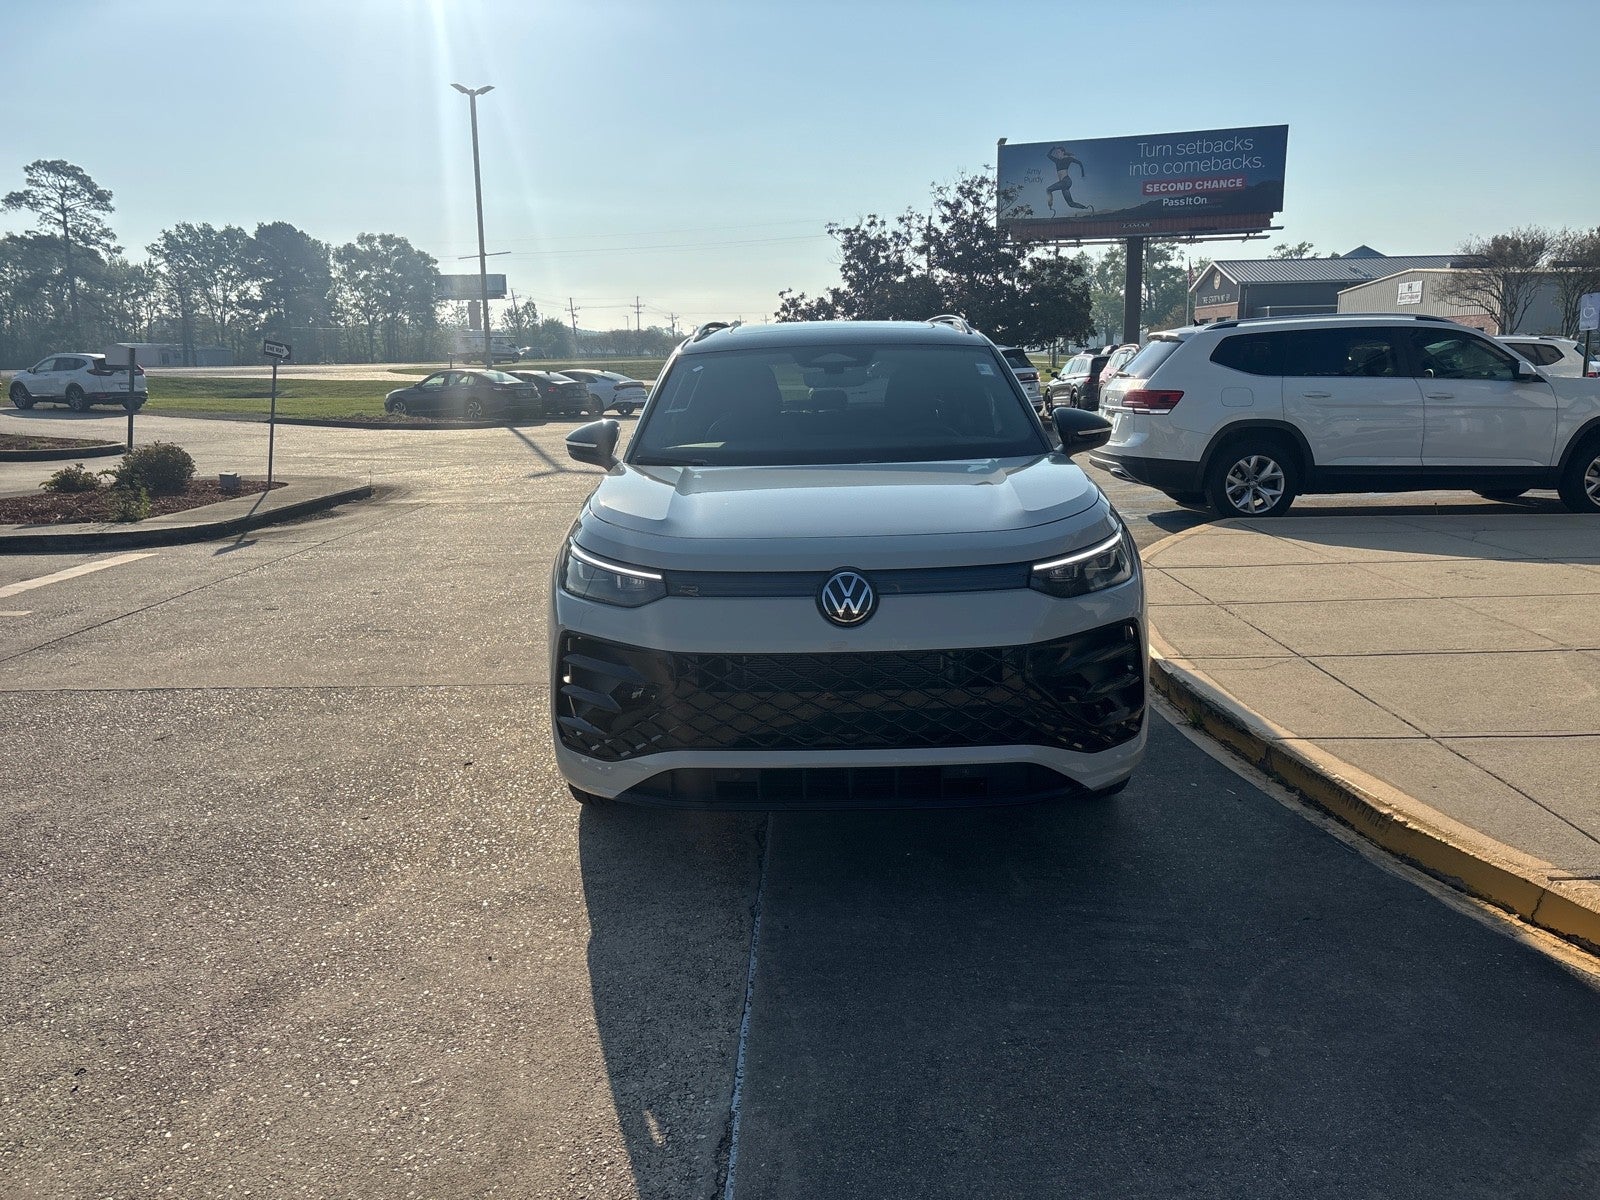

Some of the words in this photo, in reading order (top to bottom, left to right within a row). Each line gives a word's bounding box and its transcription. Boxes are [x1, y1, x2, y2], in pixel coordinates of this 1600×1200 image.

[1137, 142, 1172, 158] Turn
[1176, 136, 1254, 156] setbacks
[1129, 161, 1159, 176] into
[1162, 154, 1266, 175] comebacks.
[1146, 181, 1193, 193] SECOND
[1195, 178, 1243, 190] CHANCE
[822, 571, 874, 623] VW
